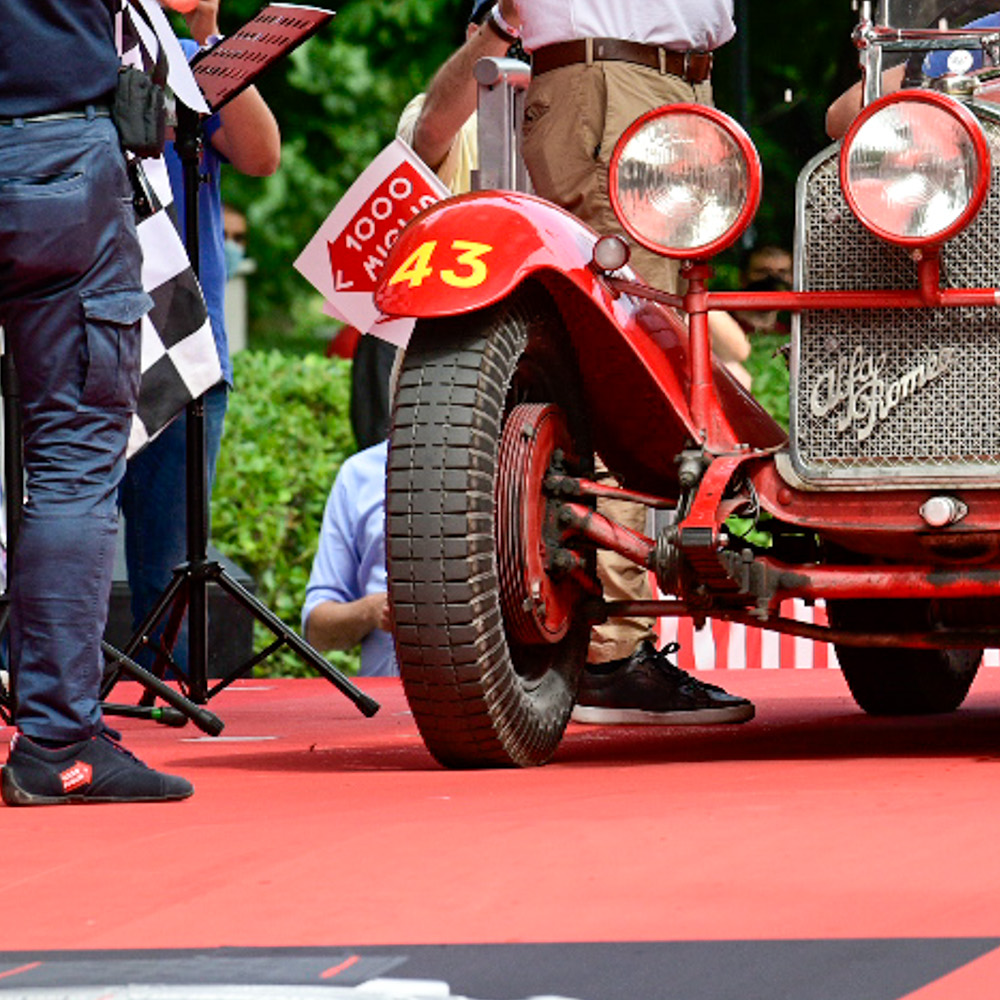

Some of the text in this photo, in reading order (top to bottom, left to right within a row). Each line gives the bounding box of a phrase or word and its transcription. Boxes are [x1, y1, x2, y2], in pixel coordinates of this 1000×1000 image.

[346, 178, 413, 252] 1000
[388, 240, 493, 288] 43
[811, 347, 885, 431] Alfa
[852, 347, 955, 441] Romeo
